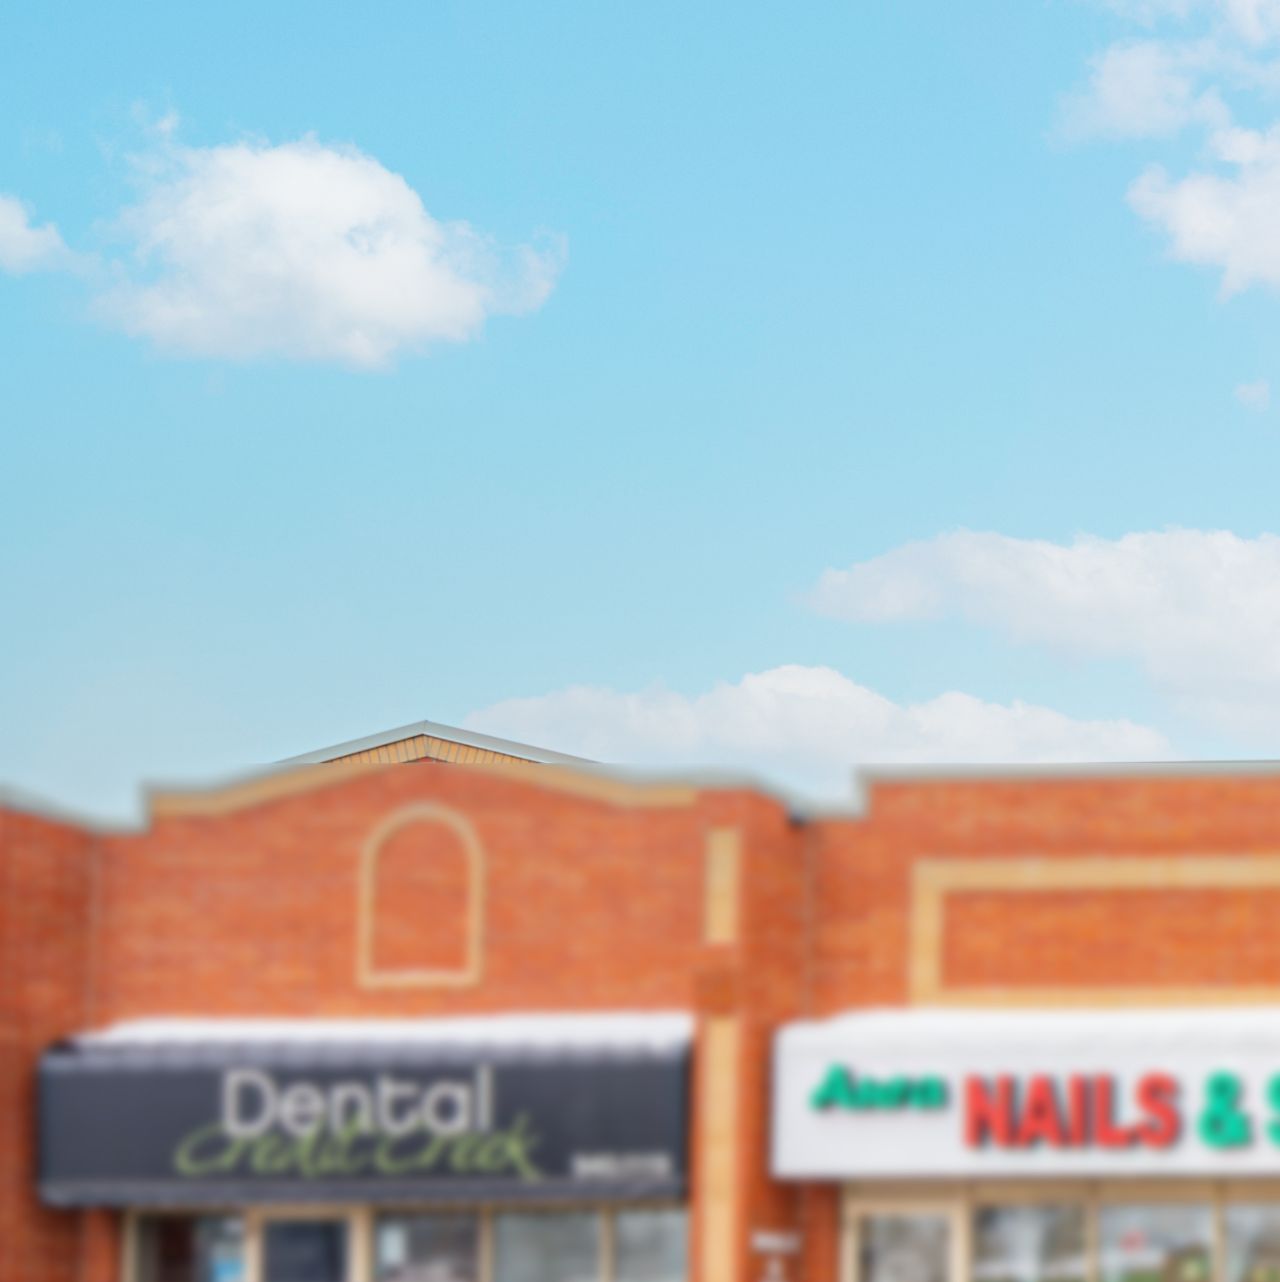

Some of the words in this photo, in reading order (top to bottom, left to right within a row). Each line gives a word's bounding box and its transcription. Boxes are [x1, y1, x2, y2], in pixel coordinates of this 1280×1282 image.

[220, 1063, 495, 1137] Dental
[960, 1070, 1184, 1150] NAILS
[1196, 1070, 1252, 1150] &
[384, 1110, 545, 1183] Creek
